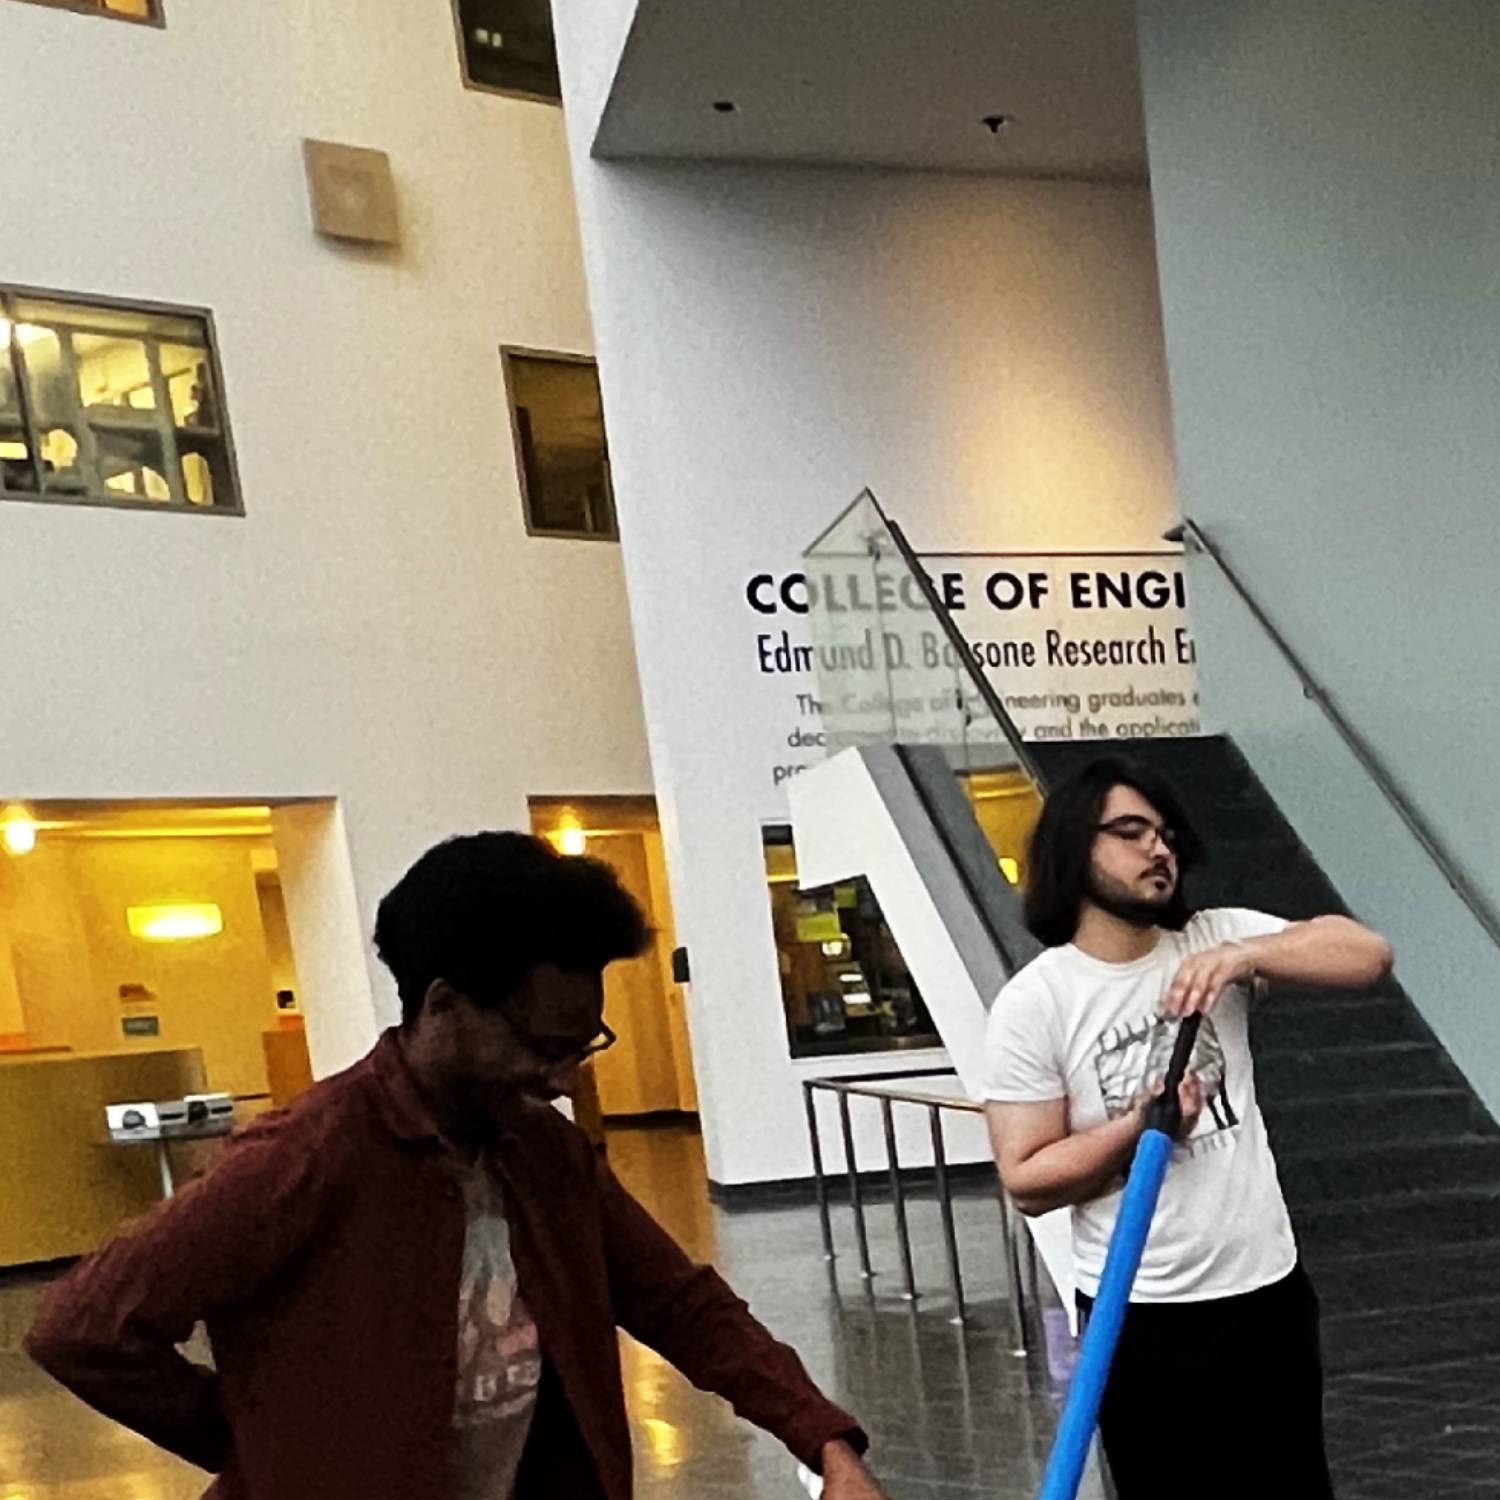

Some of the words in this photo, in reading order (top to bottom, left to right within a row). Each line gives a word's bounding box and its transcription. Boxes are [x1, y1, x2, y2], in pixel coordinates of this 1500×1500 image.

[747, 572, 965, 614] COLLEGE
[987, 572, 1048, 610] OF
[1071, 571, 1186, 609] ENGI
[757, 630, 876, 673] Edmund
[921, 631, 1036, 669] Bosone
[1046, 625, 1166, 666] Research
[1087, 684, 1186, 713] graduates
